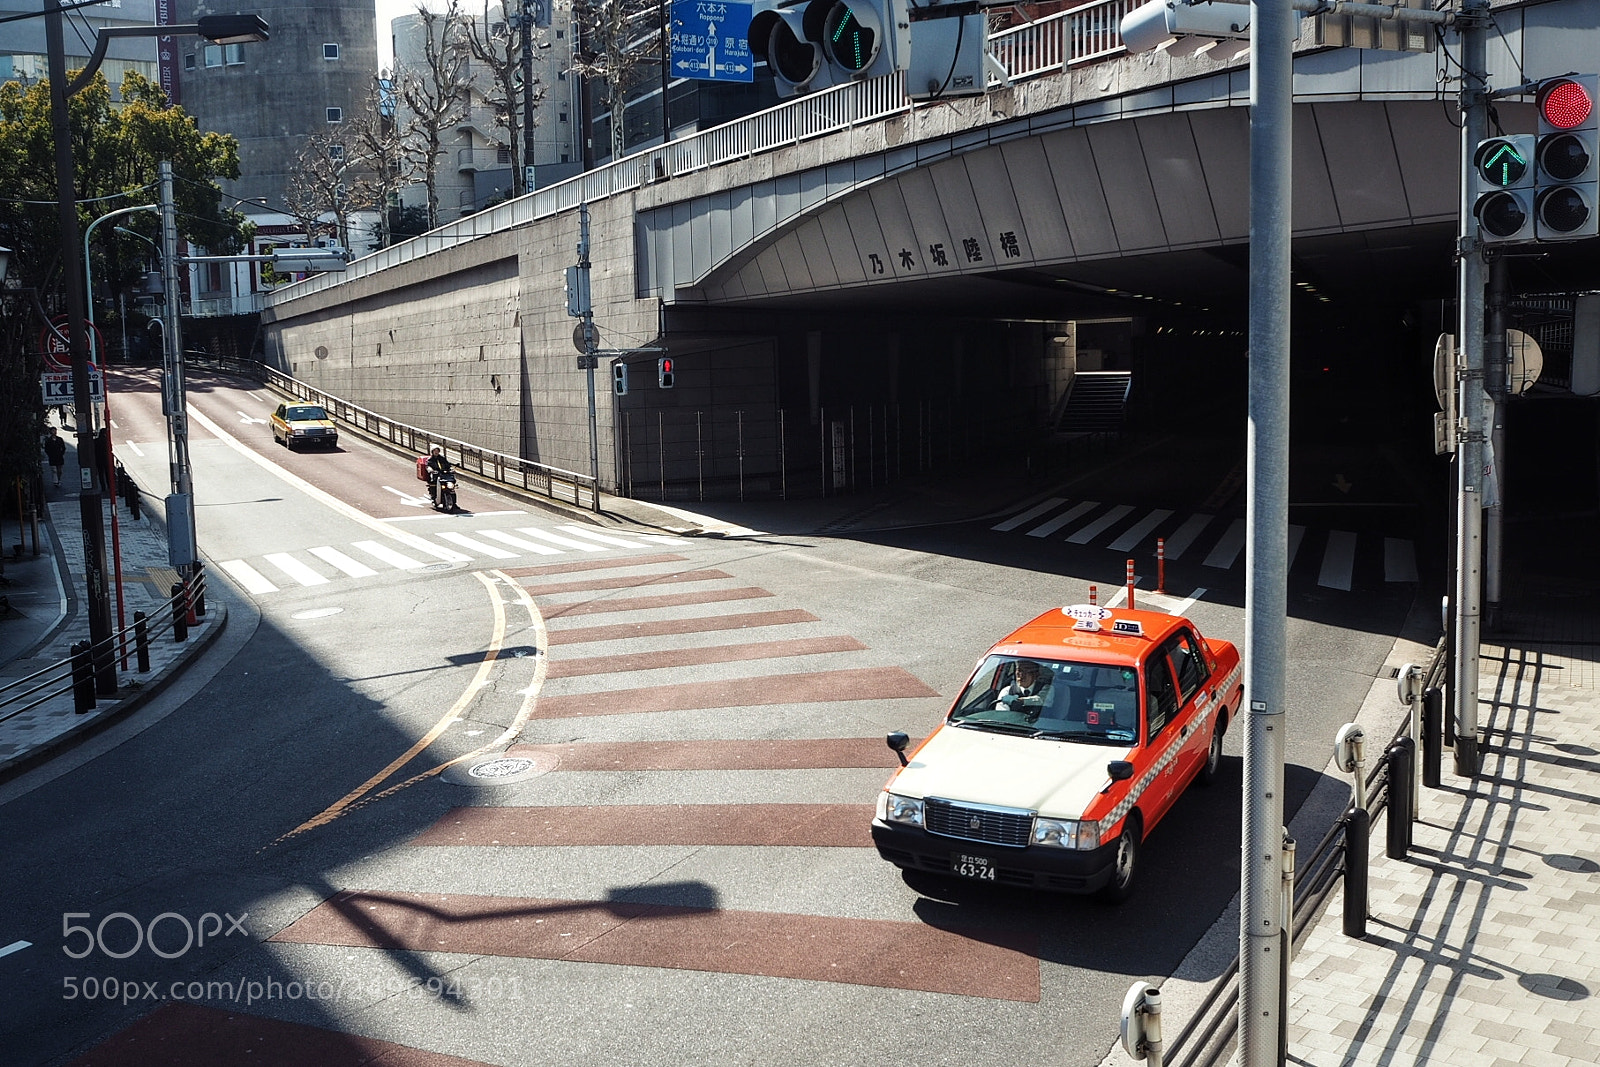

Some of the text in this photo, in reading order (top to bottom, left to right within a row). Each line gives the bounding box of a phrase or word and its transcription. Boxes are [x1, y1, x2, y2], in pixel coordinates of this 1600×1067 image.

[696, 2, 727, 15] 六本木
[699, 13, 725, 22] Roppongi
[672, 32, 705, 47] 外堀通り
[724, 37, 748, 51] 原宿
[724, 49, 749, 57] Harajuku
[868, 231, 1021, 275] 乃木坂陸橋
[1077, 620, 1094, 628] 三和
[974, 857, 988, 866] 500
[960, 863, 995, 881] 63-24
